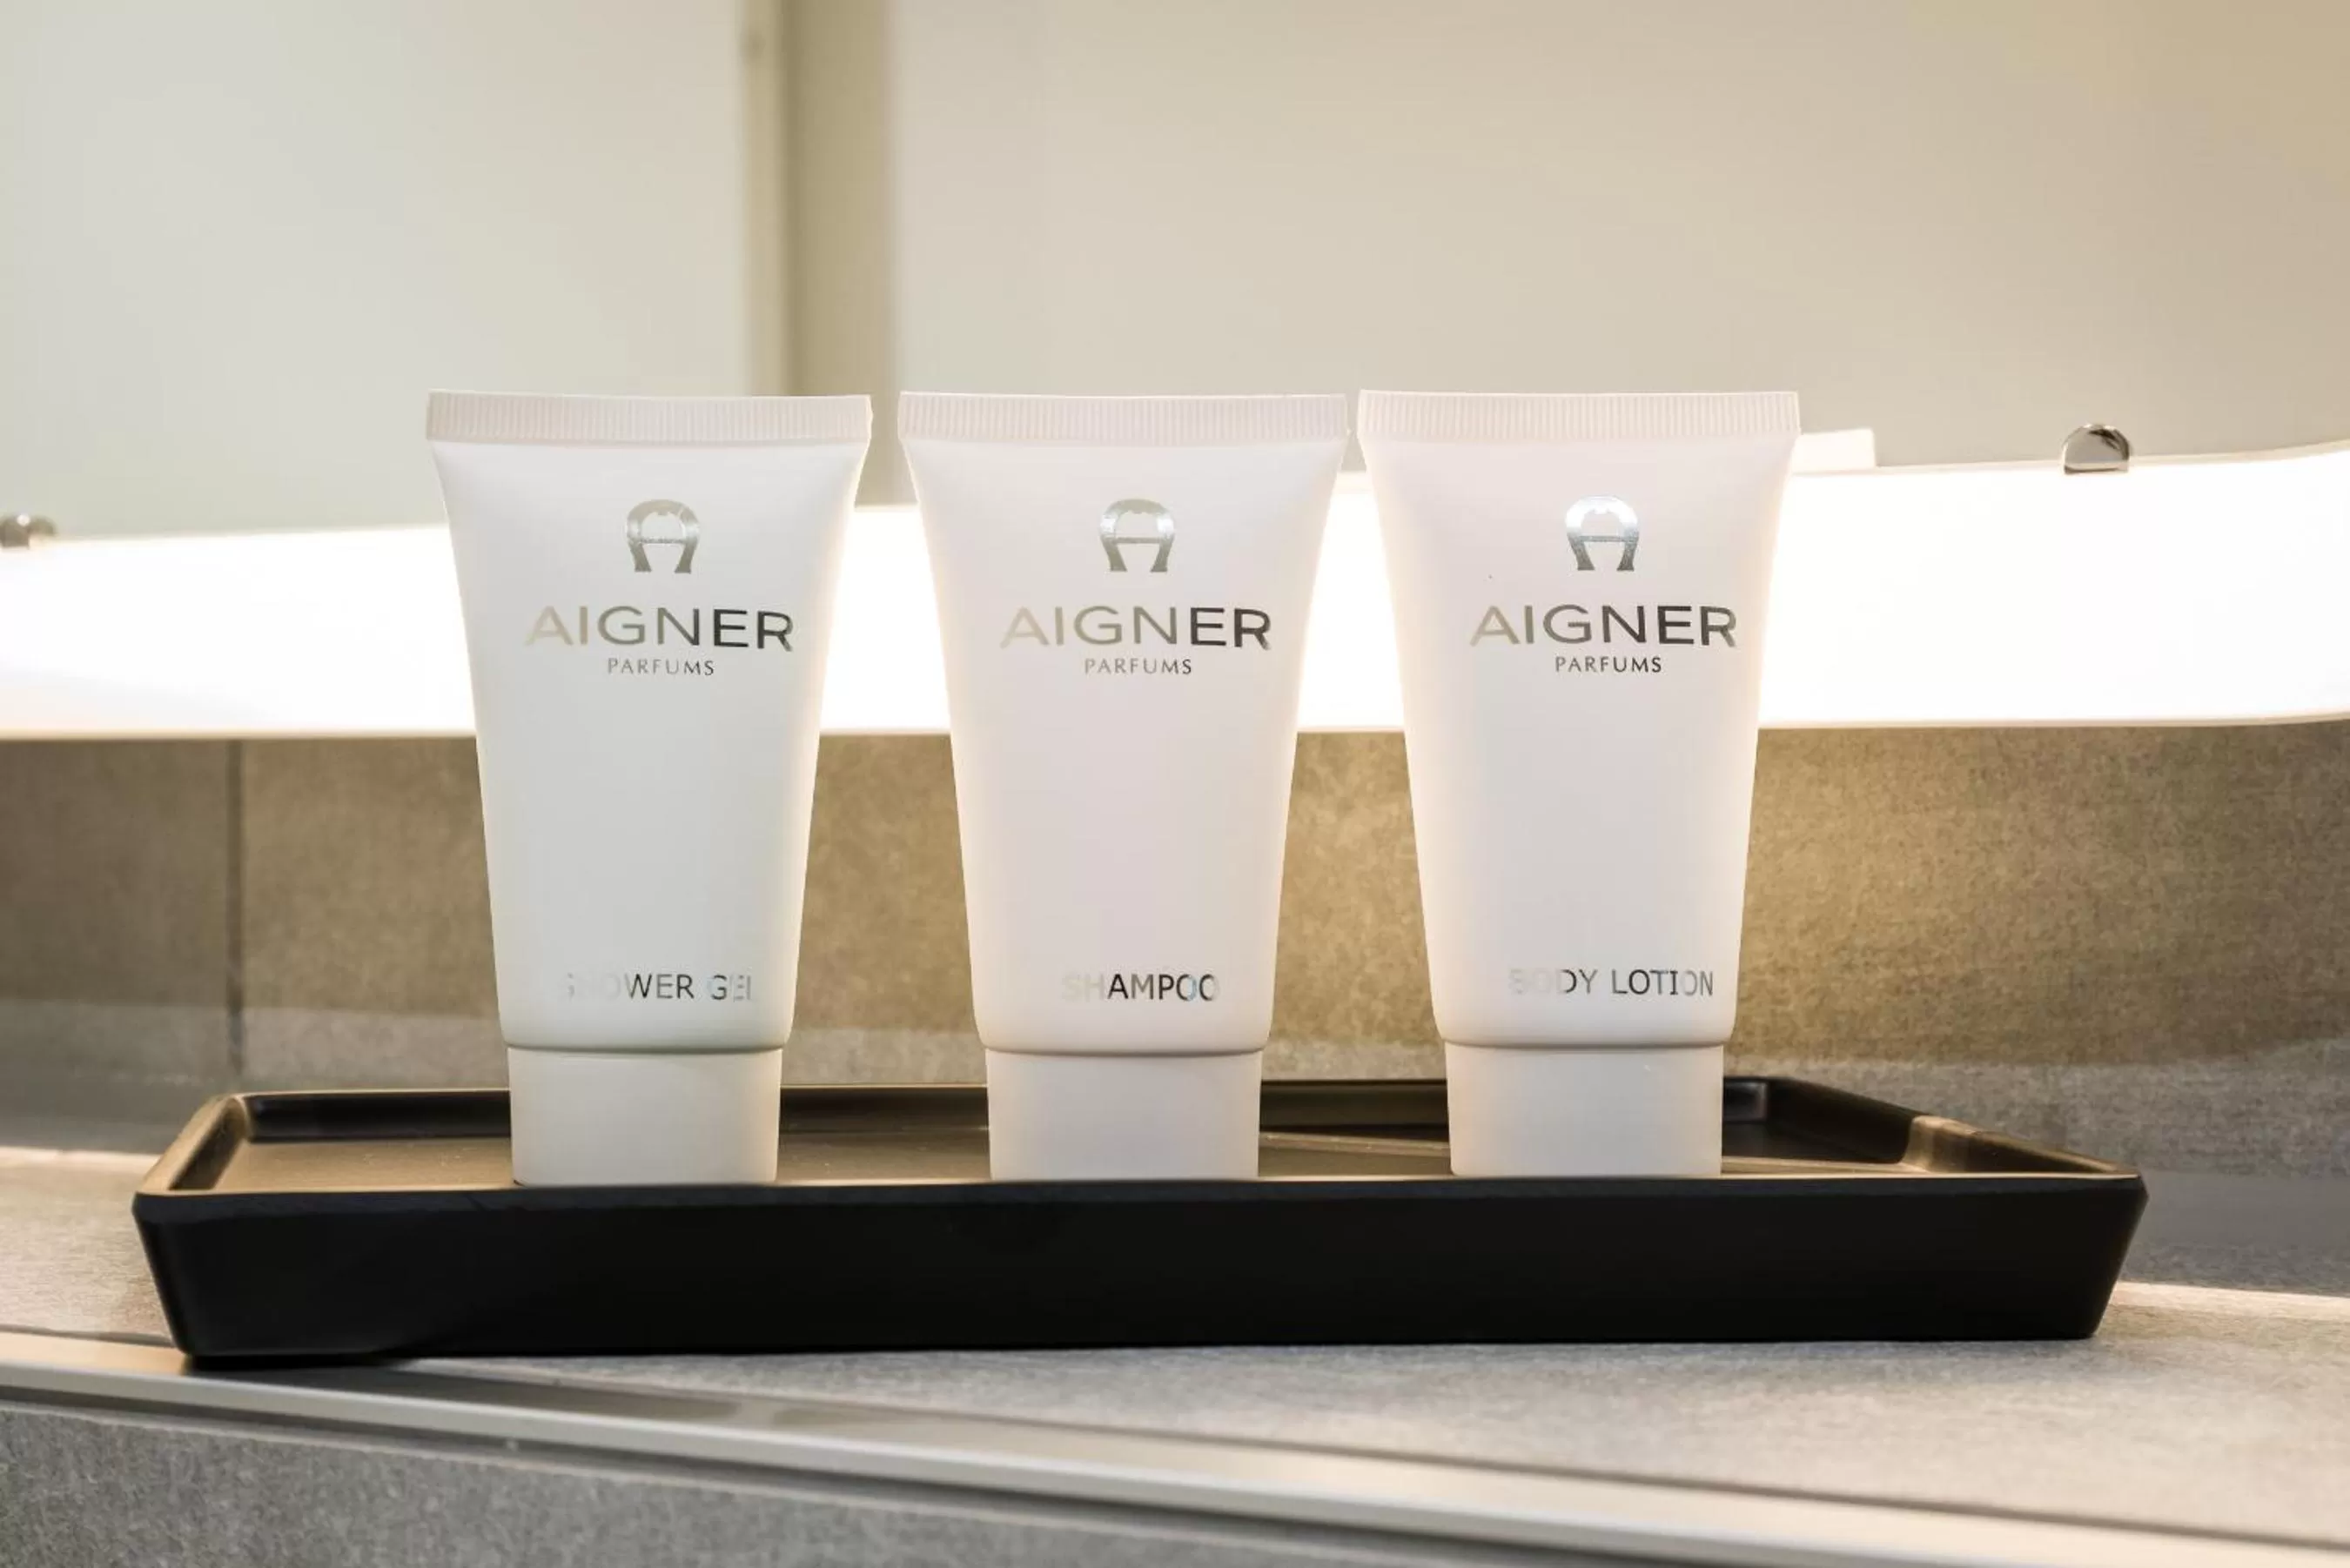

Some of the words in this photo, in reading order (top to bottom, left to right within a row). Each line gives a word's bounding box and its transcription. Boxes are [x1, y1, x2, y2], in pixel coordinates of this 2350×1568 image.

[525, 605, 794, 652] AIGNER
[1000, 605, 1272, 651] AIGNER
[1469, 604, 1737, 648] AIGNER
[607, 657, 715, 676] PARFUMS
[1084, 657, 1192, 675] PARFUMS
[1554, 655, 1662, 673] PARFUMS
[561, 972, 695, 1001] SOWER
[1064, 973, 1220, 1002] SHAMPOO
[1509, 968, 1598, 995] BODY
[1611, 968, 1714, 996] LOTION
